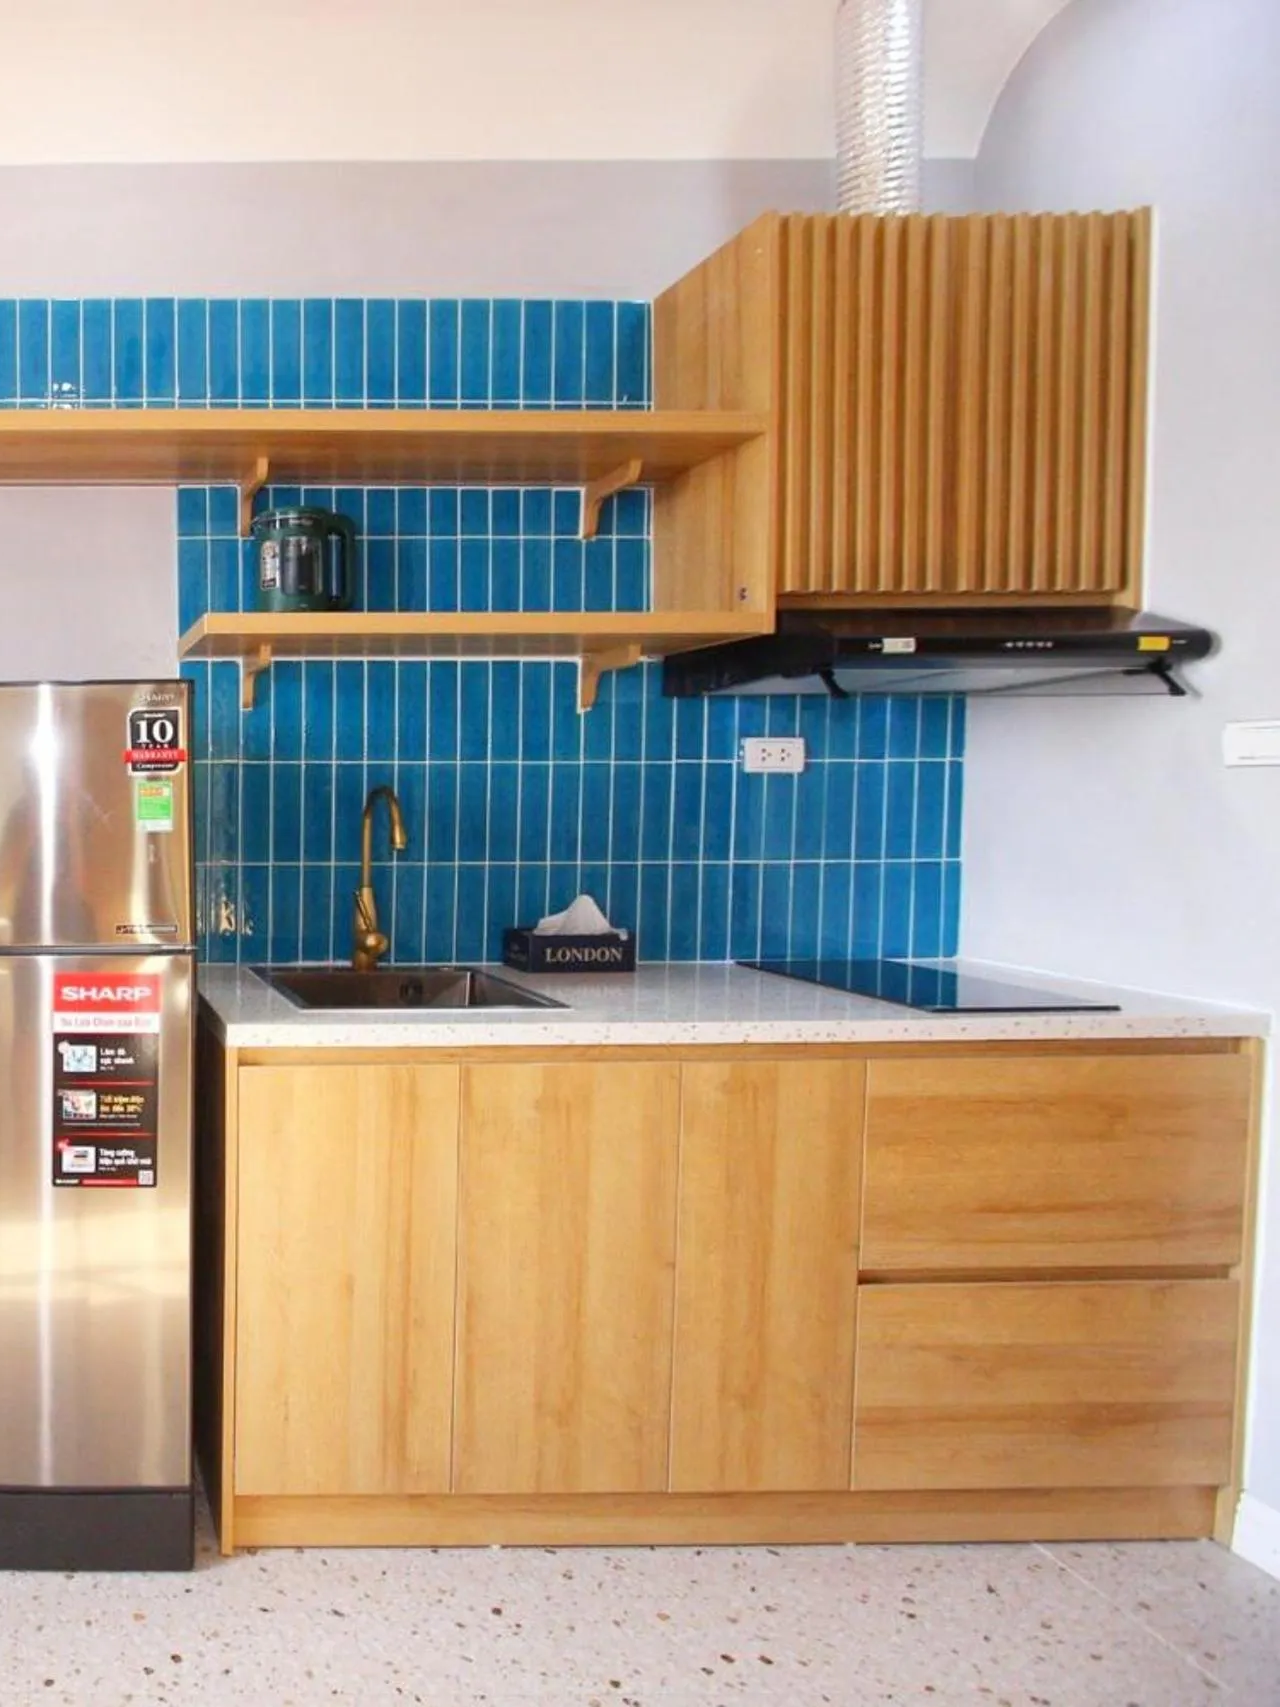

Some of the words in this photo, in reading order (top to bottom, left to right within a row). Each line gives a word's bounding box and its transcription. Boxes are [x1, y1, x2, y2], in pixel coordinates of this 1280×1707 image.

[136, 719, 173, 743] 10
[545, 947, 623, 962] LONDON
[61, 985, 152, 1002] SHARP
